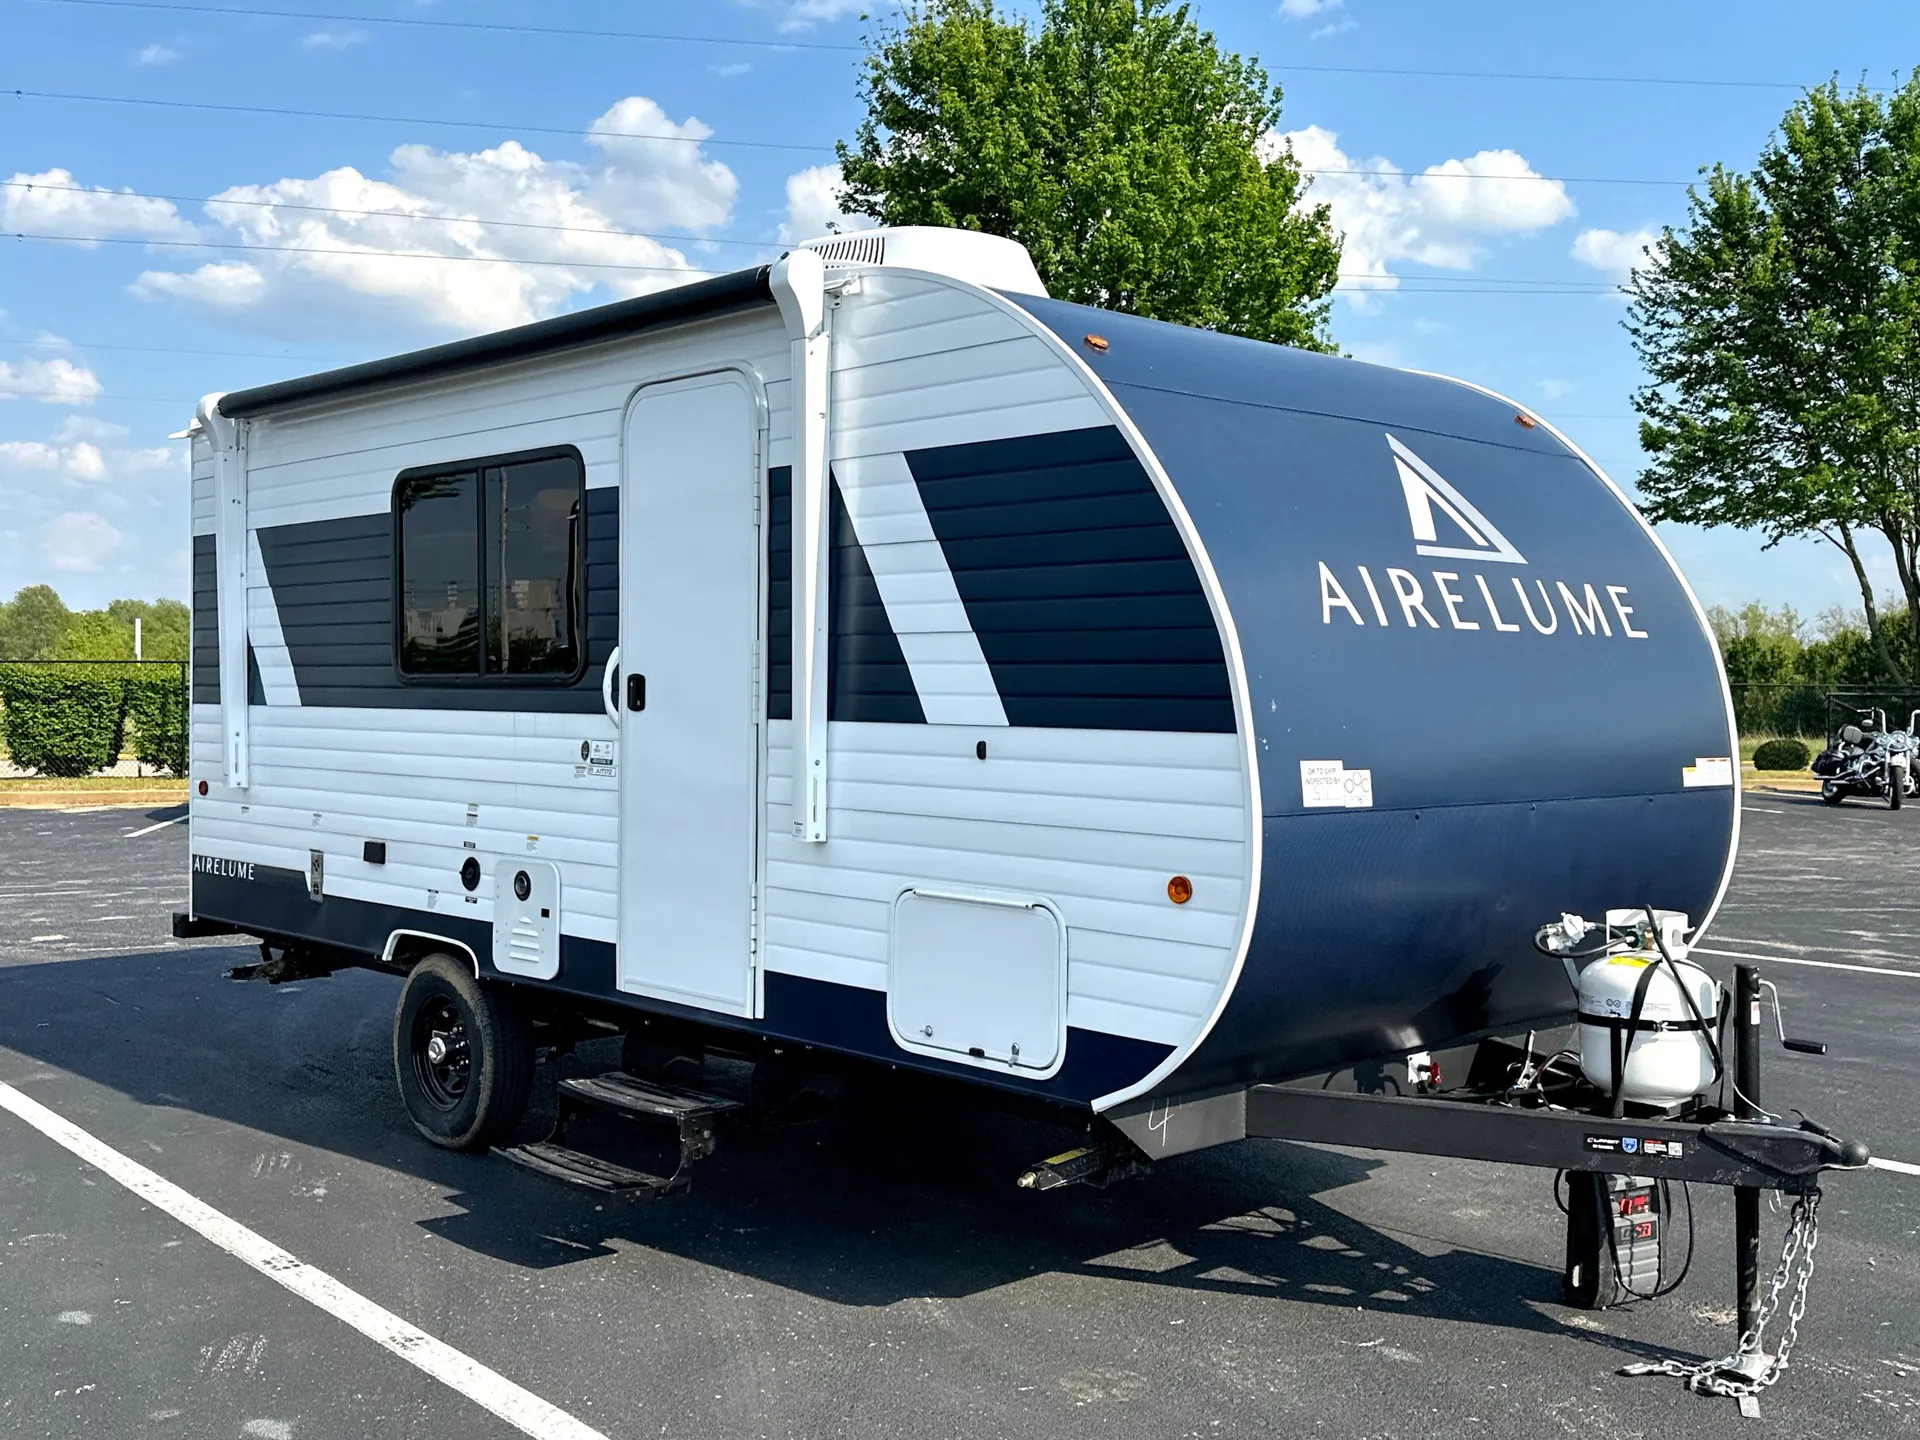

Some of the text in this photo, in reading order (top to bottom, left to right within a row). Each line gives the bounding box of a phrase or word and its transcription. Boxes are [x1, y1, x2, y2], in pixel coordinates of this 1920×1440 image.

[1318, 561, 1649, 639] AIRELUME
[193, 855, 255, 881] AIRELUME
[1148, 1097, 1175, 1147] 4
